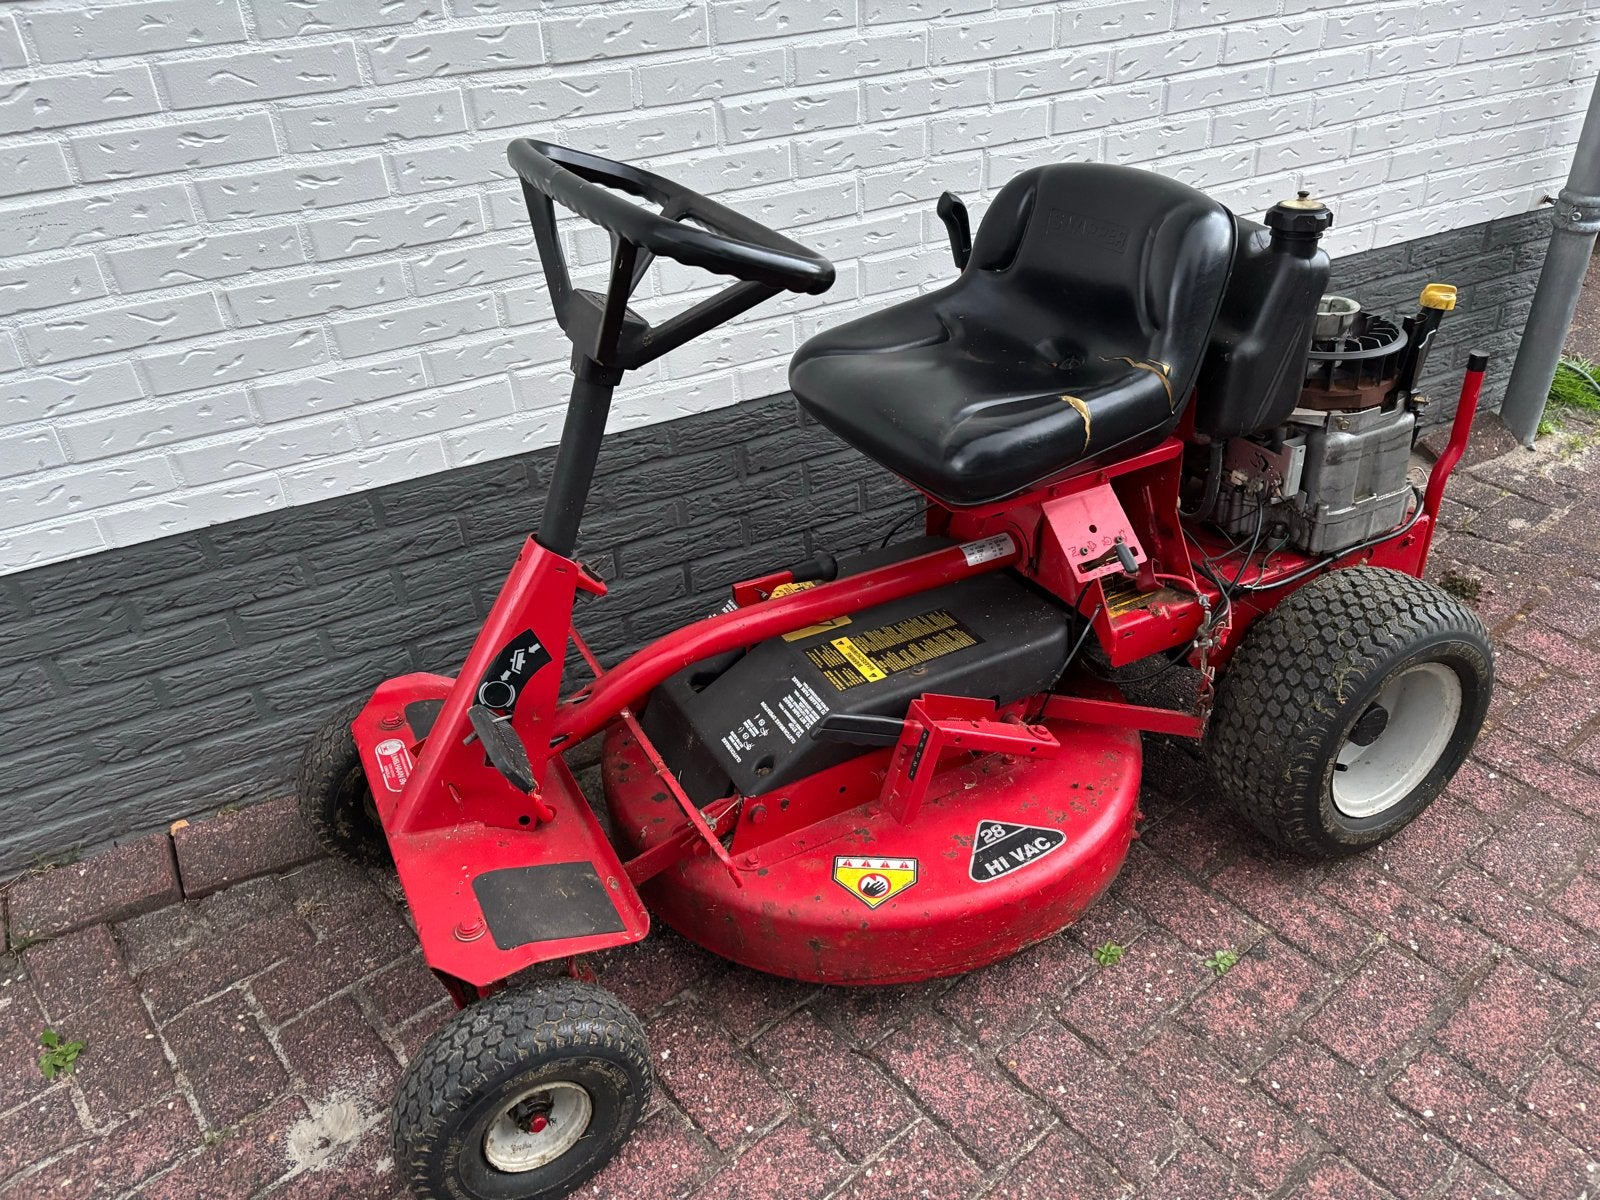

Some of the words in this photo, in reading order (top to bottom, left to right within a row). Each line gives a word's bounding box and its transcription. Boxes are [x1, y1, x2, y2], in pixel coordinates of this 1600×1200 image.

[980, 824, 1006, 845] 28
[984, 859, 1010, 876] HI
[1009, 836, 1051, 862] VAC
